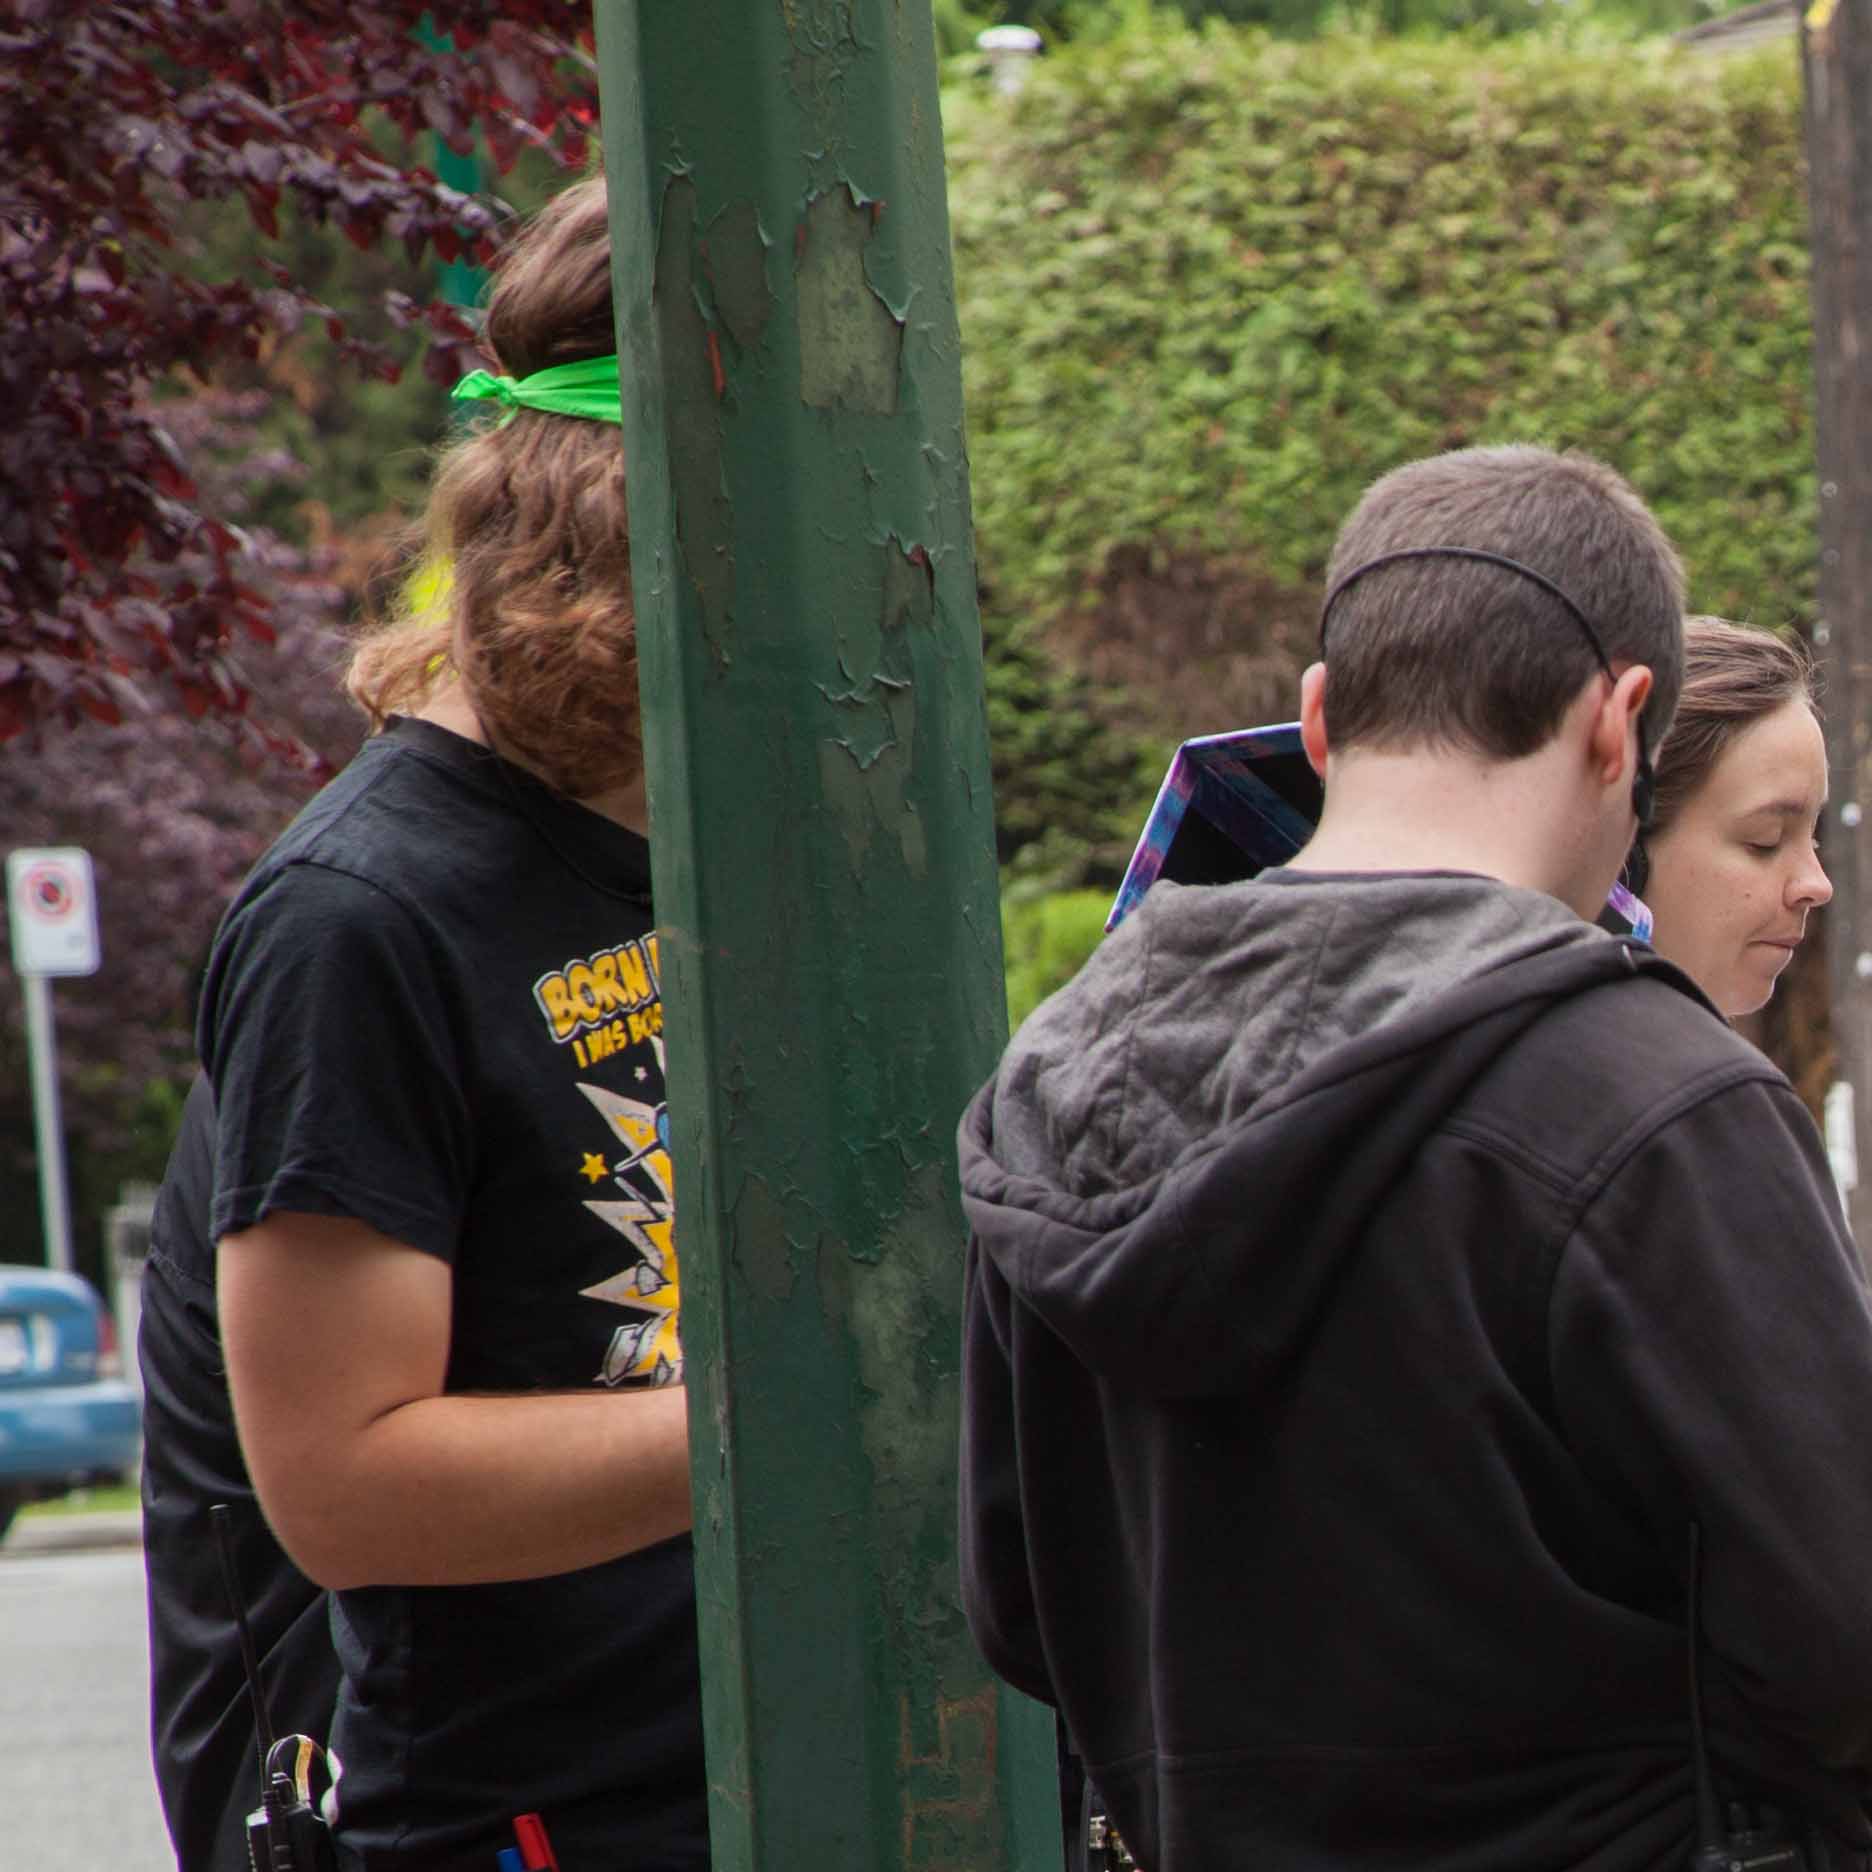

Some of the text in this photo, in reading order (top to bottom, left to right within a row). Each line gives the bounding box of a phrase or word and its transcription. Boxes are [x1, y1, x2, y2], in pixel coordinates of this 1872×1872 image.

[533, 941, 656, 1043] BORN
[571, 1040, 589, 1068] I
[585, 1019, 628, 1063] WAS
